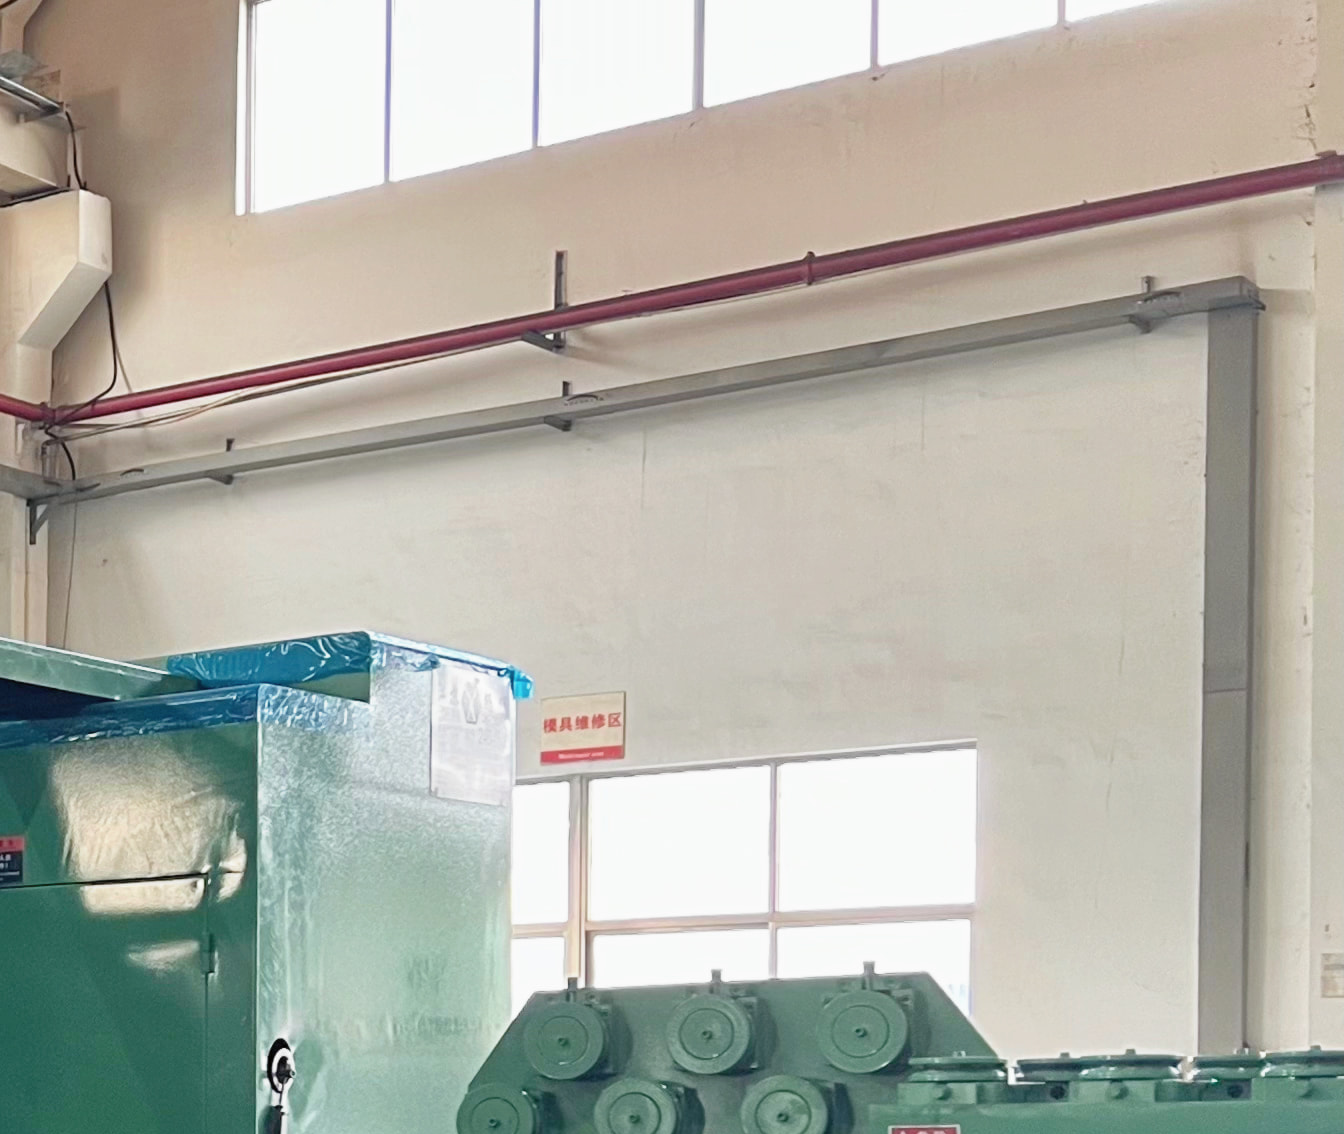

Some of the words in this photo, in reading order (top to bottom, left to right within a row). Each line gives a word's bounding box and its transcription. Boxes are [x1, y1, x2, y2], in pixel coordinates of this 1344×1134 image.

[543, 712, 622, 734] 模具维修区
